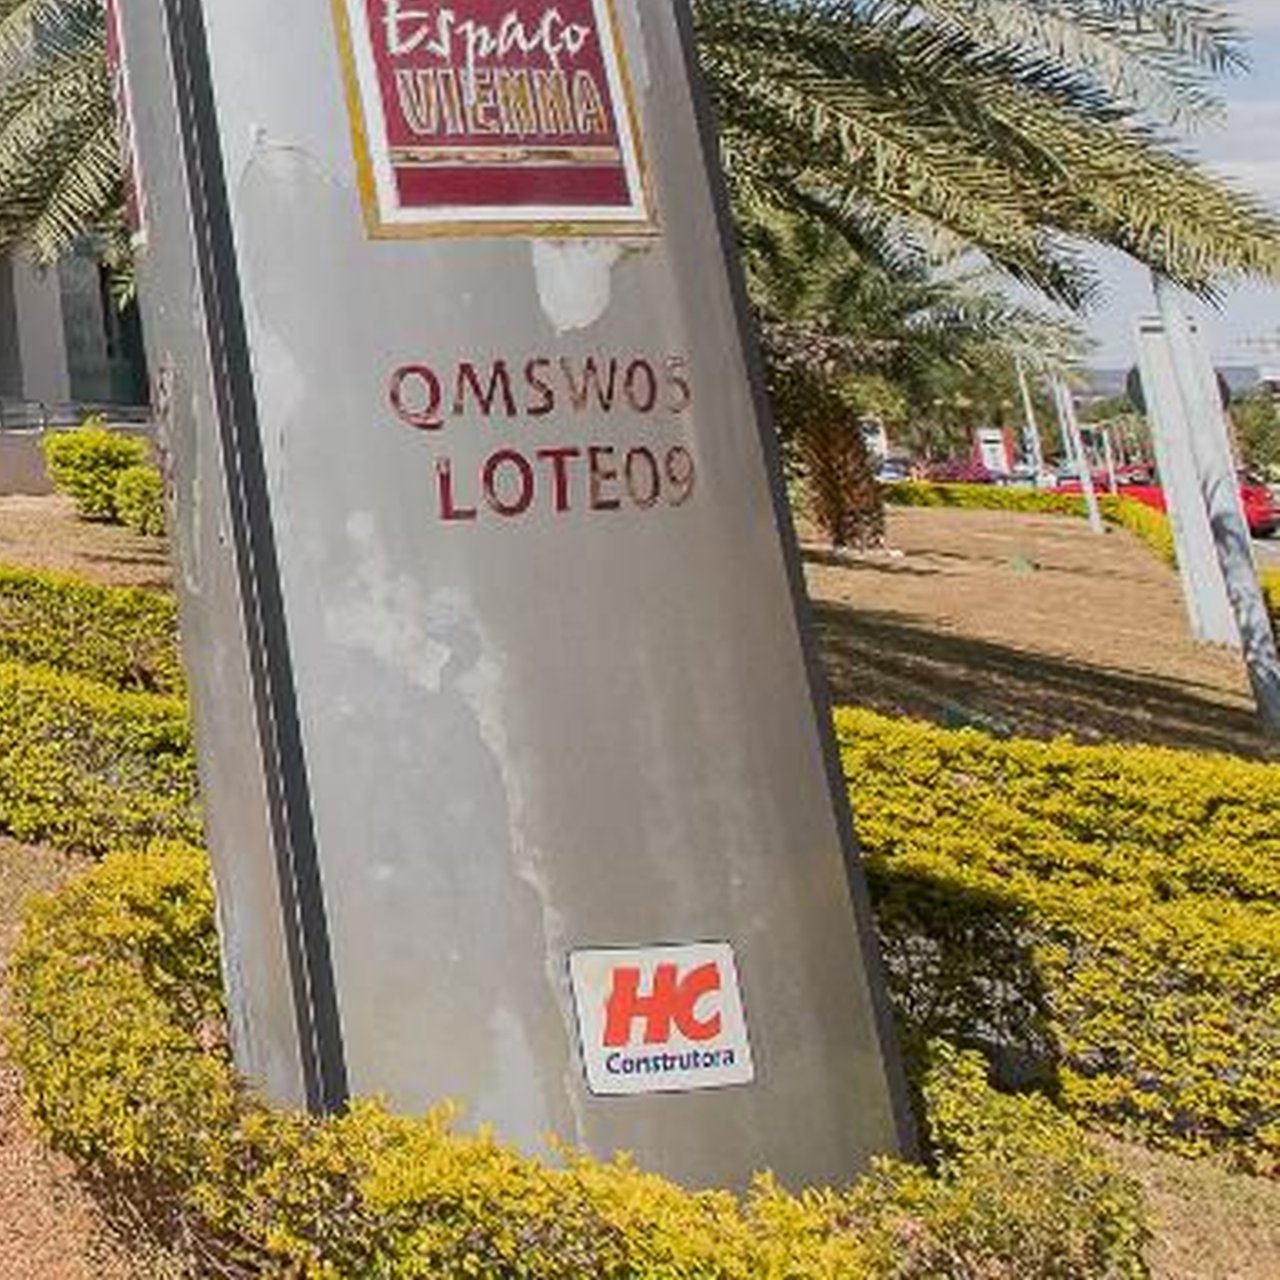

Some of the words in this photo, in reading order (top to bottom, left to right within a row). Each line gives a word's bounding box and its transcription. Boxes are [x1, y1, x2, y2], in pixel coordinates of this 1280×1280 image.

[388, 355, 691, 430] QMSW05
[438, 445, 696, 520] LOTE09
[603, 962, 721, 1047] HC
[606, 1049, 735, 1074] Construtora
